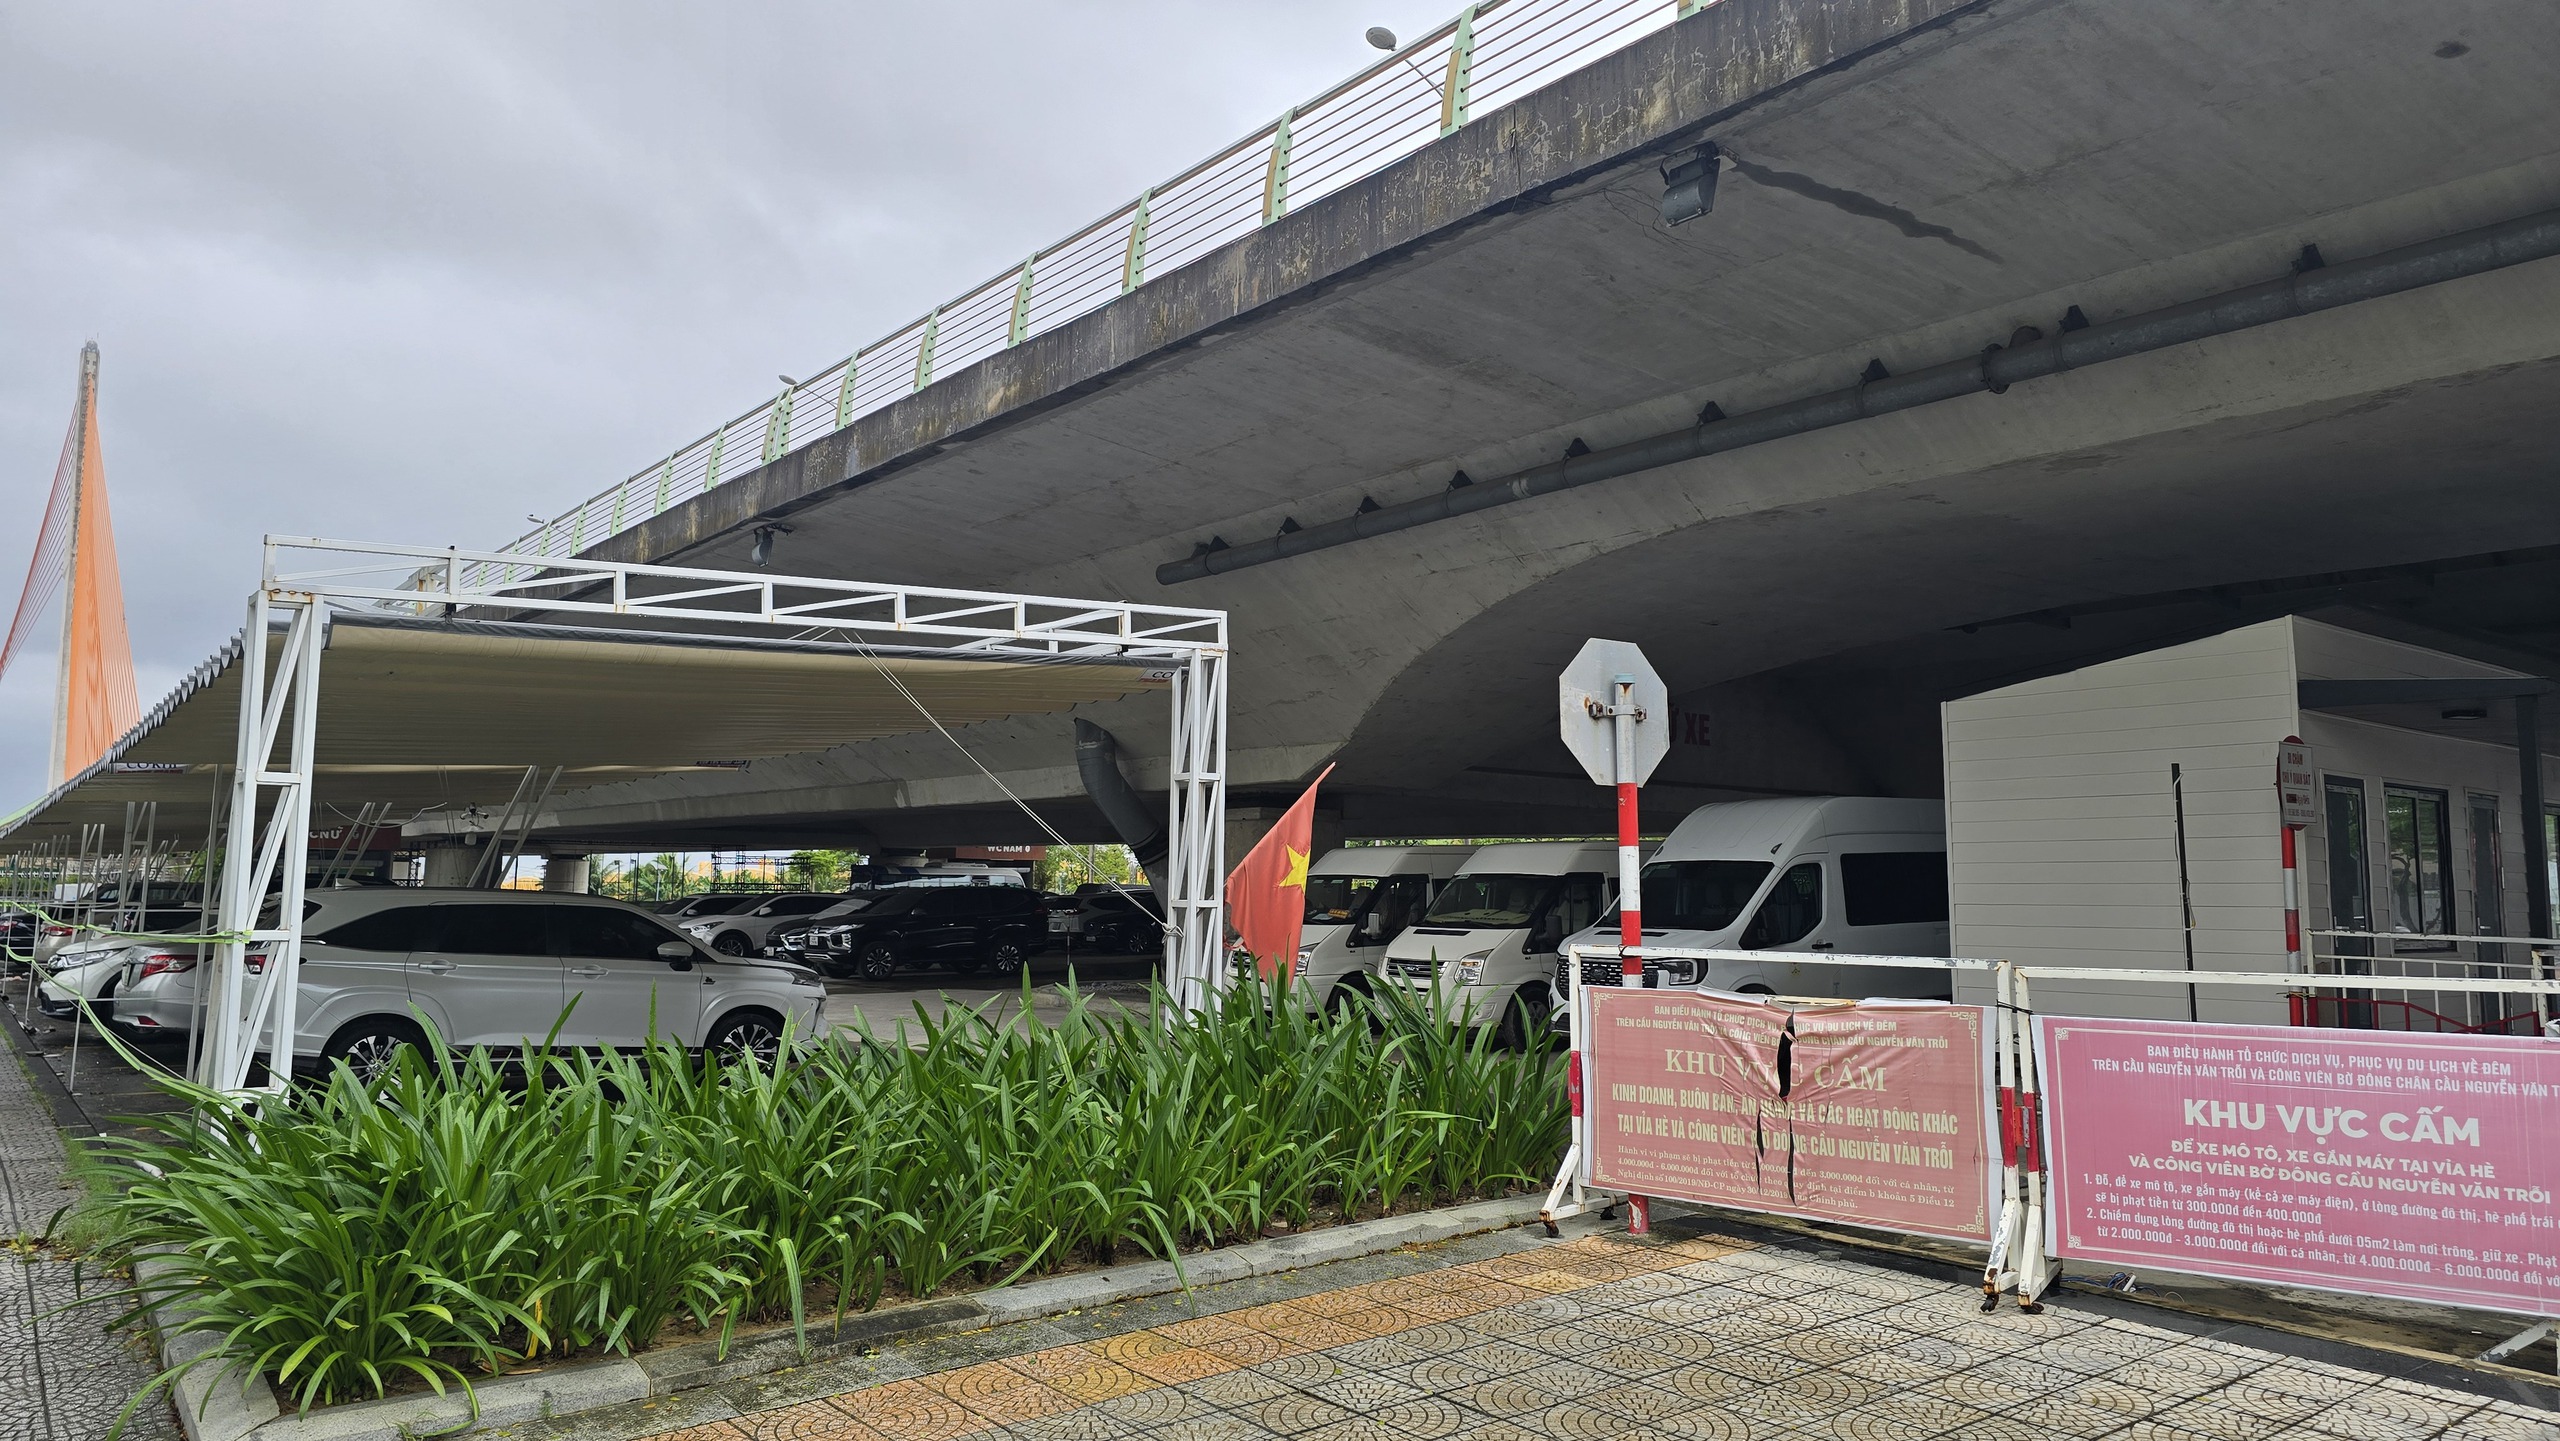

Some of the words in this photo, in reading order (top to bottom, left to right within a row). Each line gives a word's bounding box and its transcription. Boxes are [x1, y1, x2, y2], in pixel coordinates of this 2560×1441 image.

[1654, 1005, 1671, 1016] BAN
[1664, 1048, 1727, 1078] KHU
[1814, 1054, 1888, 1092] CẤM
[2092, 1058, 2120, 1072] TRÊN
[2122, 1057, 2144, 1073] CẦU
[2147, 1060, 2192, 1076] NGUYỄN
[2194, 1063, 2218, 1078] VĂN
[2220, 1063, 2246, 1080] TRỖI
[2250, 1066, 2265, 1081] VÀ
[2268, 1067, 2301, 1082] CÔNG
[2304, 1070, 2333, 1085] VIÊN
[2337, 1071, 2353, 1086] BỜ
[2357, 1072, 2392, 1088] ĐÔNG
[2396, 1075, 2430, 1090] CHÂN
[2434, 1075, 2460, 1092] CẦU
[2464, 1078, 2517, 1095] NGUYỄN
[2521, 1082, 2548, 1097] VĂN
[2147, 1045, 2170, 1058] BAN
[2172, 1043, 2199, 1059] ĐIỀU
[2203, 1046, 2234, 1061] HÀNH
[2237, 1045, 2251, 1062] TỔ
[2254, 1050, 2288, 1064] CHỨC
[2291, 1052, 2320, 1067] DỊCH
[2324, 1054, 2345, 1069] VỤ,
[2348, 1055, 2382, 1071] PHỤC
[2385, 1057, 2402, 1072] VỤ
[2407, 1058, 2424, 1071] DU
[2429, 1059, 2458, 1074] LỊCH
[2461, 1057, 2479, 1075] VỀ
[2481, 1060, 2511, 1076] ĐÊM
[1612, 1083, 1637, 1102] KINH
[1639, 1085, 1678, 1109] DOANH,
[1680, 1087, 1710, 1111] BUÔN
[1712, 1090, 1739, 1116] BÁN,
[1799, 1099, 1815, 1123] VÀ
[1818, 1101, 1844, 1125] CÁC
[1847, 1106, 1879, 1132] HOẠT
[1883, 1106, 1920, 1135] ĐỘNG
[1922, 1109, 1958, 1136] KHÁC
[2184, 1098, 2266, 1130] KHU
[2275, 1104, 2369, 1145] VỰC
[2379, 1105, 2480, 1147] CẤM
[1617, 1113, 1634, 1136] TẠI
[1655, 1114, 1669, 1136] HÈ
[1671, 1116, 1686, 1139] VÀ
[1687, 1118, 1718, 1143] CÔNG
[1720, 1123, 1746, 1147] VIÊN
[1810, 1130, 1836, 1158] CẦU
[1838, 1135, 1890, 1164] NGUYỄN
[1893, 1140, 1920, 1167] VĂN
[1923, 1141, 1953, 1170] TRỖI
[2171, 1137, 2194, 1154] ĐỂ
[2197, 1142, 2219, 1156] XE
[2222, 1142, 2251, 1158] MÔ
[2254, 1144, 2282, 1163] TÔ,
[2286, 1149, 2309, 1163] XE
[2356, 1154, 2395, 1171] MÁY
[2399, 1158, 2429, 1177] TẠI
[2469, 1161, 2496, 1179] HÈ
[2083, 1173, 2093, 1185] 1.
[2130, 1178, 2141, 1189] xe
[2145, 1179, 2160, 1191] mô
[2163, 1181, 2178, 1194] tô,
[2180, 1184, 2193, 1194] xe
[2219, 1187, 2241, 1201] máy
[2265, 1189, 2279, 1202] cả
[2282, 1193, 2294, 1204] xe
[2298, 1194, 2321, 1208] máy
[2325, 1196, 2358, 1212] điện),
[2372, 1200, 2399, 1216] lòng
[2401, 1203, 2438, 1219] đường
[2441, 1206, 2456, 1219] đô
[2459, 1208, 2481, 1223] thị,
[2485, 1210, 2500, 1223] hè
[2504, 1212, 2527, 1226] phố
[2530, 1213, 2554, 1229] trái
[2128, 1153, 2150, 1169] VÀ
[2153, 1156, 2202, 1173] CÔNG
[2205, 1161, 2246, 1177] VIÊN
[2249, 1164, 2275, 1179] BỜ
[2278, 1166, 2332, 1185] ĐÔNG
[2335, 1170, 2374, 1188] CẦU
[2378, 1176, 2456, 1196] NGUYỄN
[2460, 1181, 2500, 1200] VĂN
[2503, 1185, 2551, 1204] TRỖI
[1944, 1198, 1955, 1208] 12
[2110, 1192, 2120, 1206] bị
[2122, 1194, 2145, 1208] phạt
[2148, 1195, 2169, 1209] tiền
[2172, 1198, 2183, 1211] từ
[2186, 1200, 2240, 1216] 300.000đ
[2242, 1204, 2262, 1219] đến
[2265, 1207, 2322, 1224] 400.000đ
[2086, 1208, 2097, 1219] 2.
[2100, 1208, 2131, 1222] Chiếm
[2134, 1212, 2160, 1227] dụng
[2161, 1215, 2185, 1230] lòng
[2187, 1217, 2220, 1233] đường
[2222, 1219, 2235, 1233] đô
[2238, 1223, 2254, 1238] thị
[2257, 1225, 2284, 1240] hoặc
[2287, 1228, 2300, 1240] hè
[2304, 1229, 2325, 1243] phố
[2328, 1232, 2353, 1246] dưới
[2356, 1236, 2390, 1250] 05m2
[2393, 1239, 2416, 1252] làm
[2420, 1243, 2438, 1255] nơi
[2482, 1248, 2502, 1262] giữ
[2505, 1253, 2524, 1264] xe.
[2527, 1252, 2558, 1269] Phạt
[2097, 1225, 2109, 1237] từ
[2111, 1226, 2173, 1244] 2.000.000đ
[2184, 1234, 2249, 1252] 3.000.000đ
[2252, 1240, 2268, 1255] đối
[2271, 1244, 2287, 1257] với
[2291, 1246, 2305, 1259] cá
[2308, 1248, 2340, 1264] nhân,
[2343, 1252, 2356, 1265] từ
[2359, 1254, 2431, 1273] 4.000.000đ
[2444, 1262, 2520, 1283] 6.000.000đ
[2523, 1270, 2543, 1285] đối
